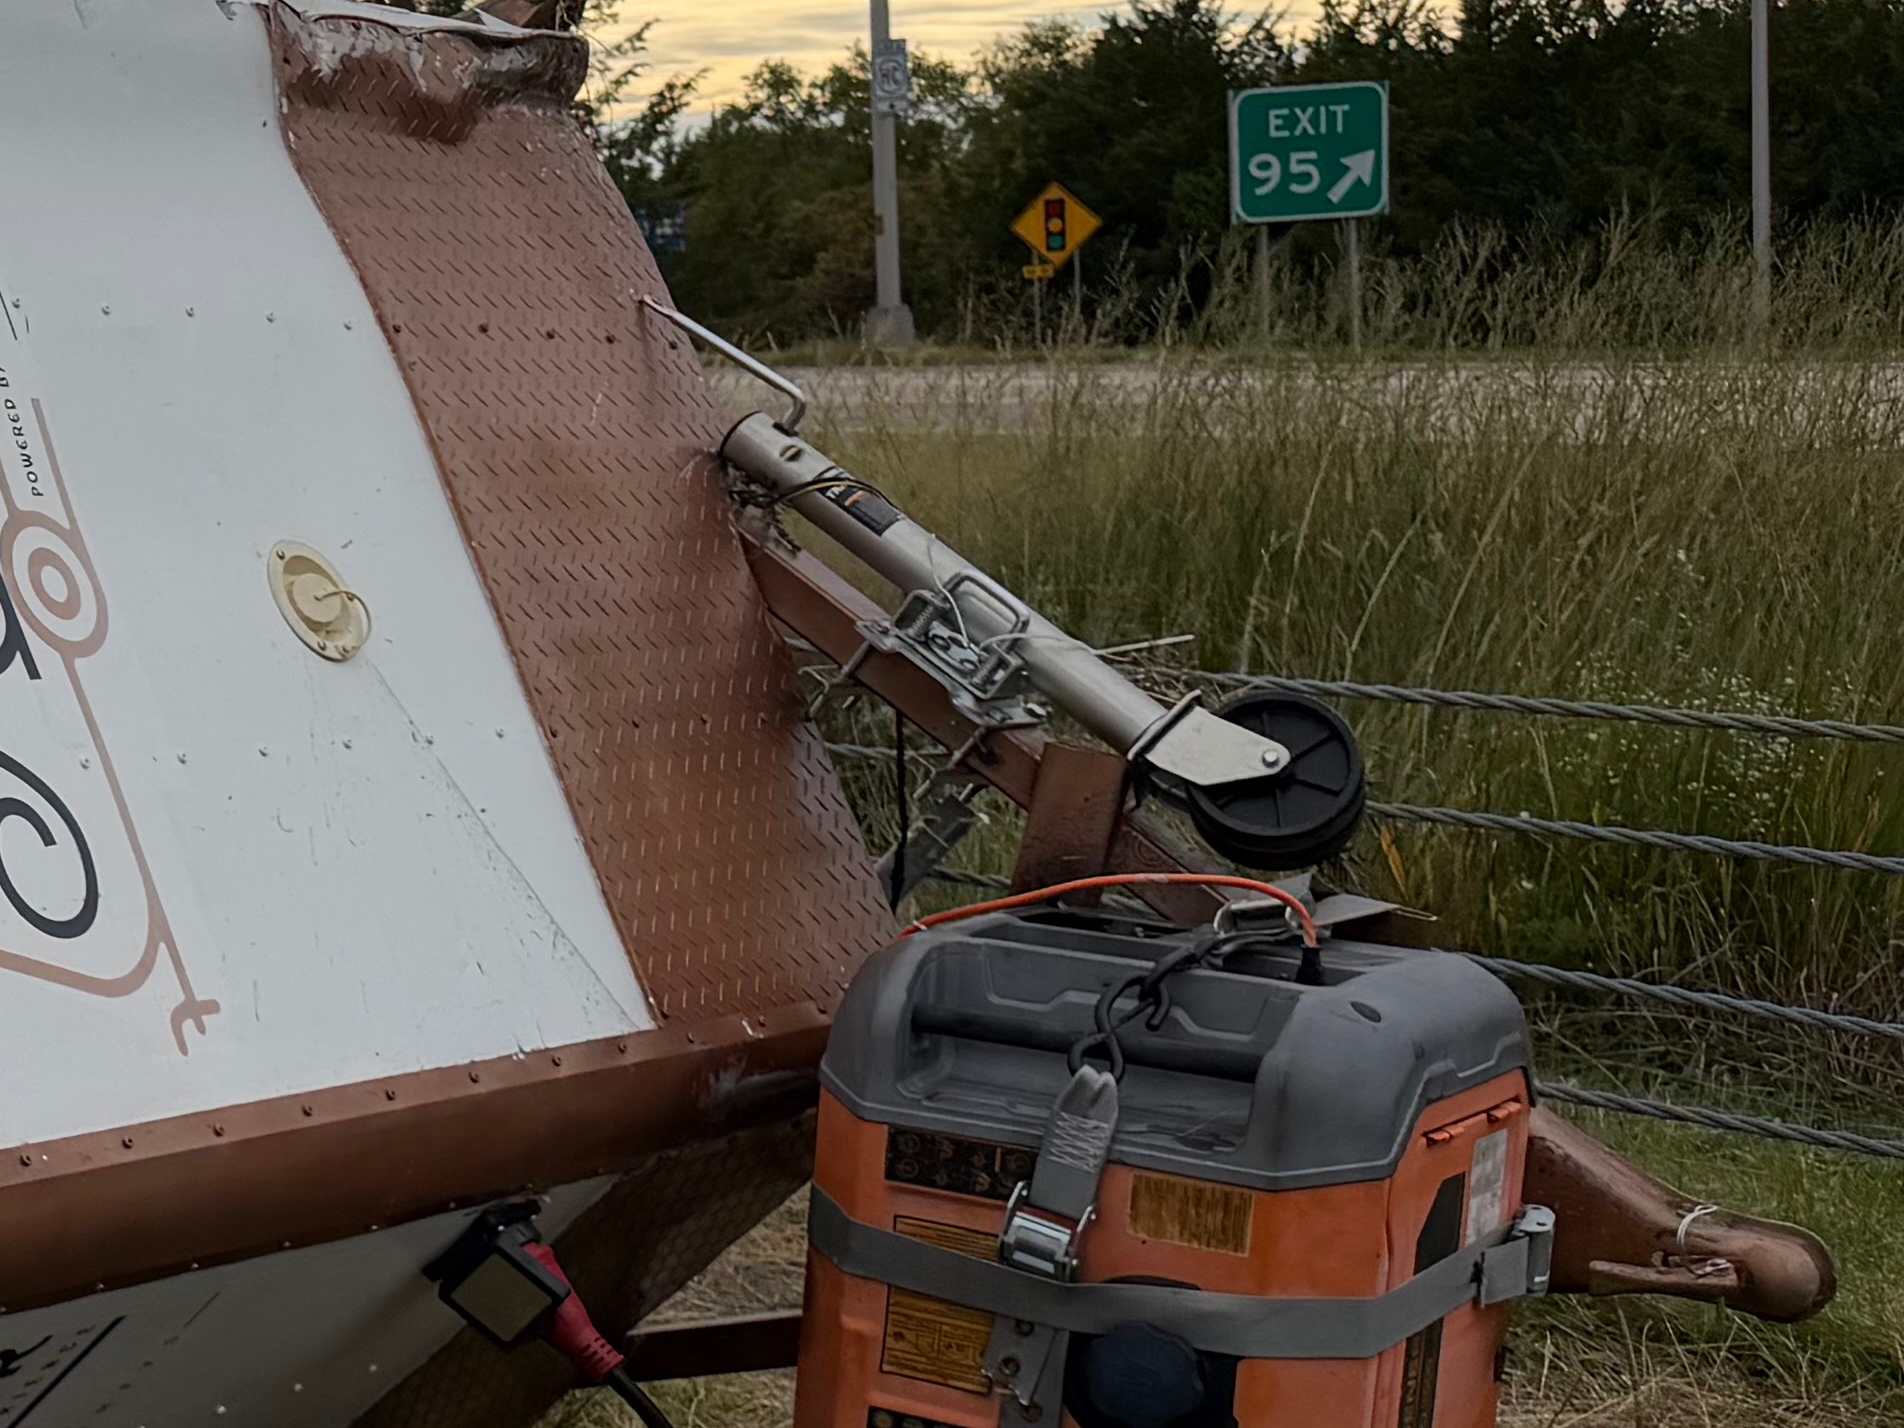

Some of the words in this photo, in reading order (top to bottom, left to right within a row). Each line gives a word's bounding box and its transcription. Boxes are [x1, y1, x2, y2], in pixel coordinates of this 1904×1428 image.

[1267, 103, 1351, 140] EXIT
[1247, 149, 1322, 196] 95
[8, 397, 45, 500] POWERED
